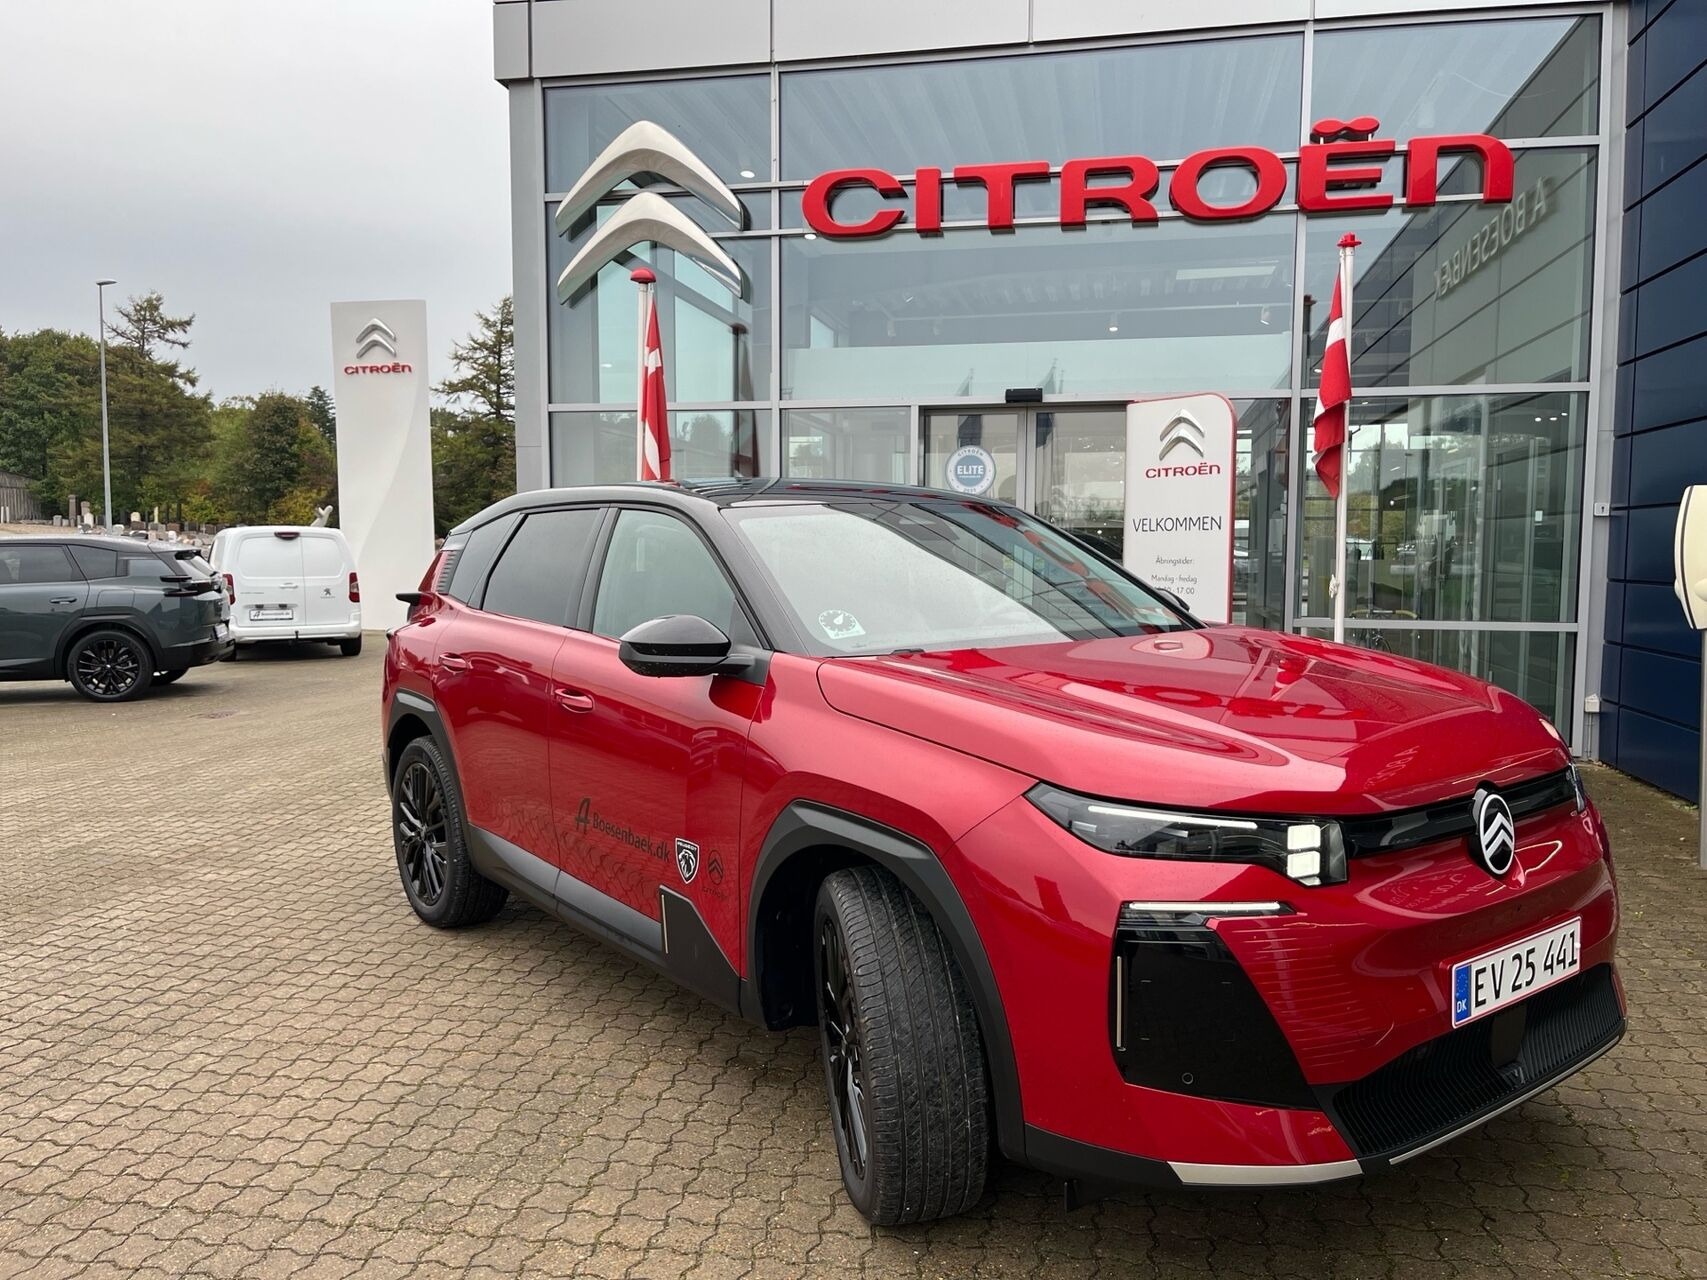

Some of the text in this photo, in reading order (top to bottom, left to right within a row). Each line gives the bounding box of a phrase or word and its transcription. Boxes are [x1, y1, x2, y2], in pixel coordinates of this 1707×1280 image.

[802, 116, 1515, 238] CITROËN
[343, 362, 412, 376] CITROËN
[956, 465, 984, 475] ELITE
[1145, 462, 1221, 479] CITROËN
[1132, 516, 1222, 533] VELKOMMEN
[592, 811, 670, 863] Boesenbaek.dk
[1474, 930, 1578, 1008] EV 25 441
[1456, 1000, 1467, 1013] DK
